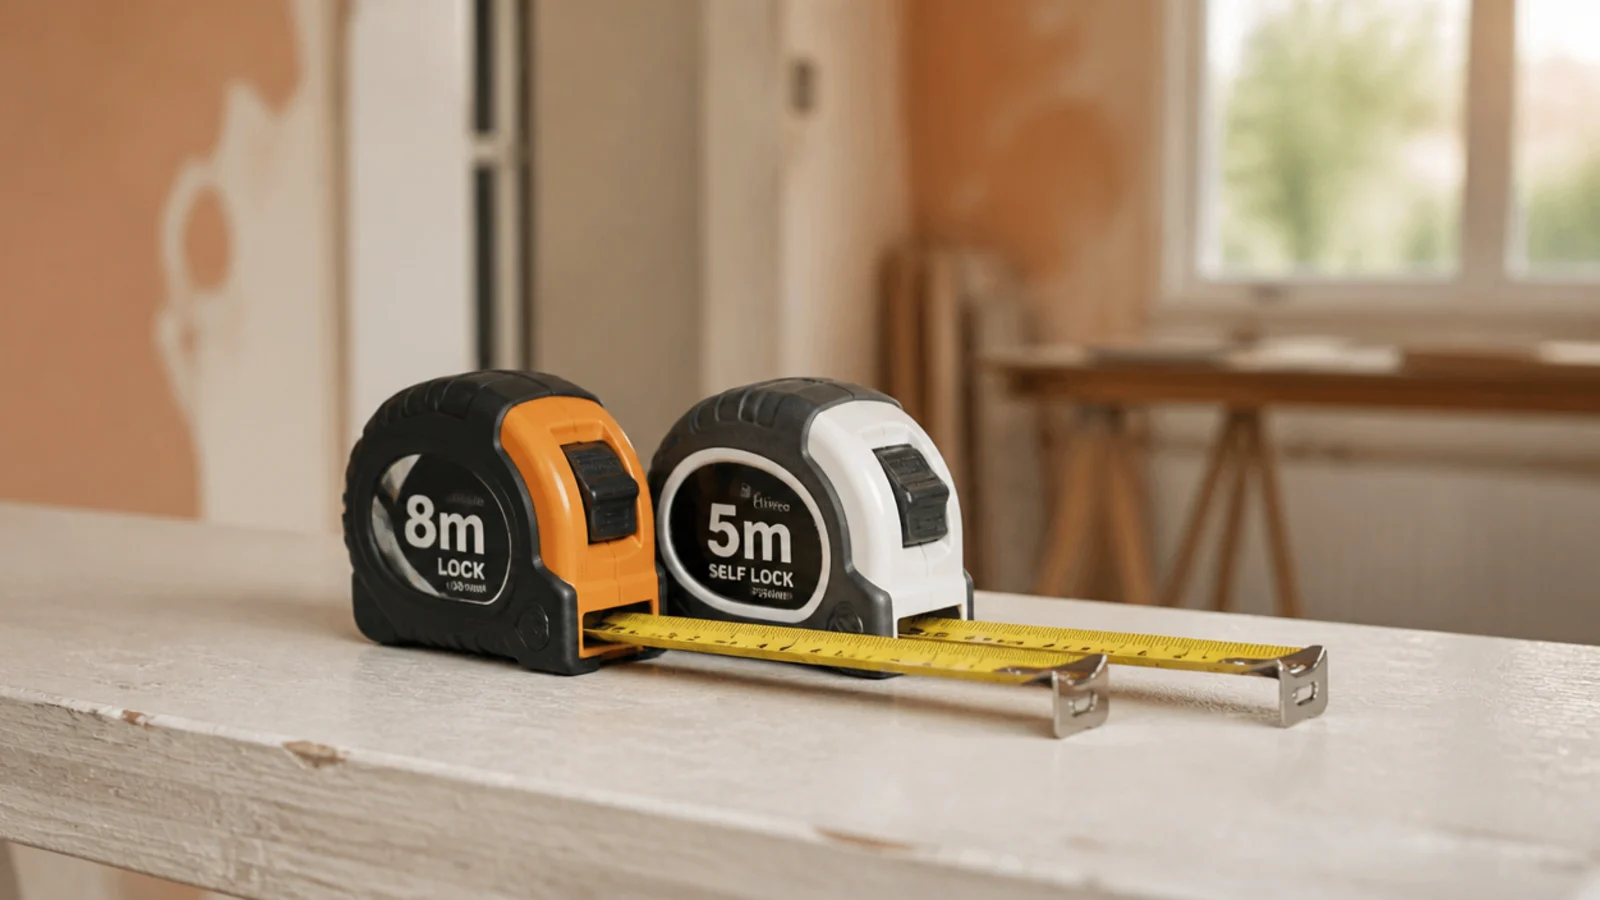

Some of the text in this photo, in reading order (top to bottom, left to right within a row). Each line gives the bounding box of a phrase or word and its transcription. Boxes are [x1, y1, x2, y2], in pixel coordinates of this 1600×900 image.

[405, 494, 485, 555] 8m
[708, 502, 792, 564] 5m
[437, 557, 485, 580] LOCK
[709, 563, 794, 588] SELF LOCK
